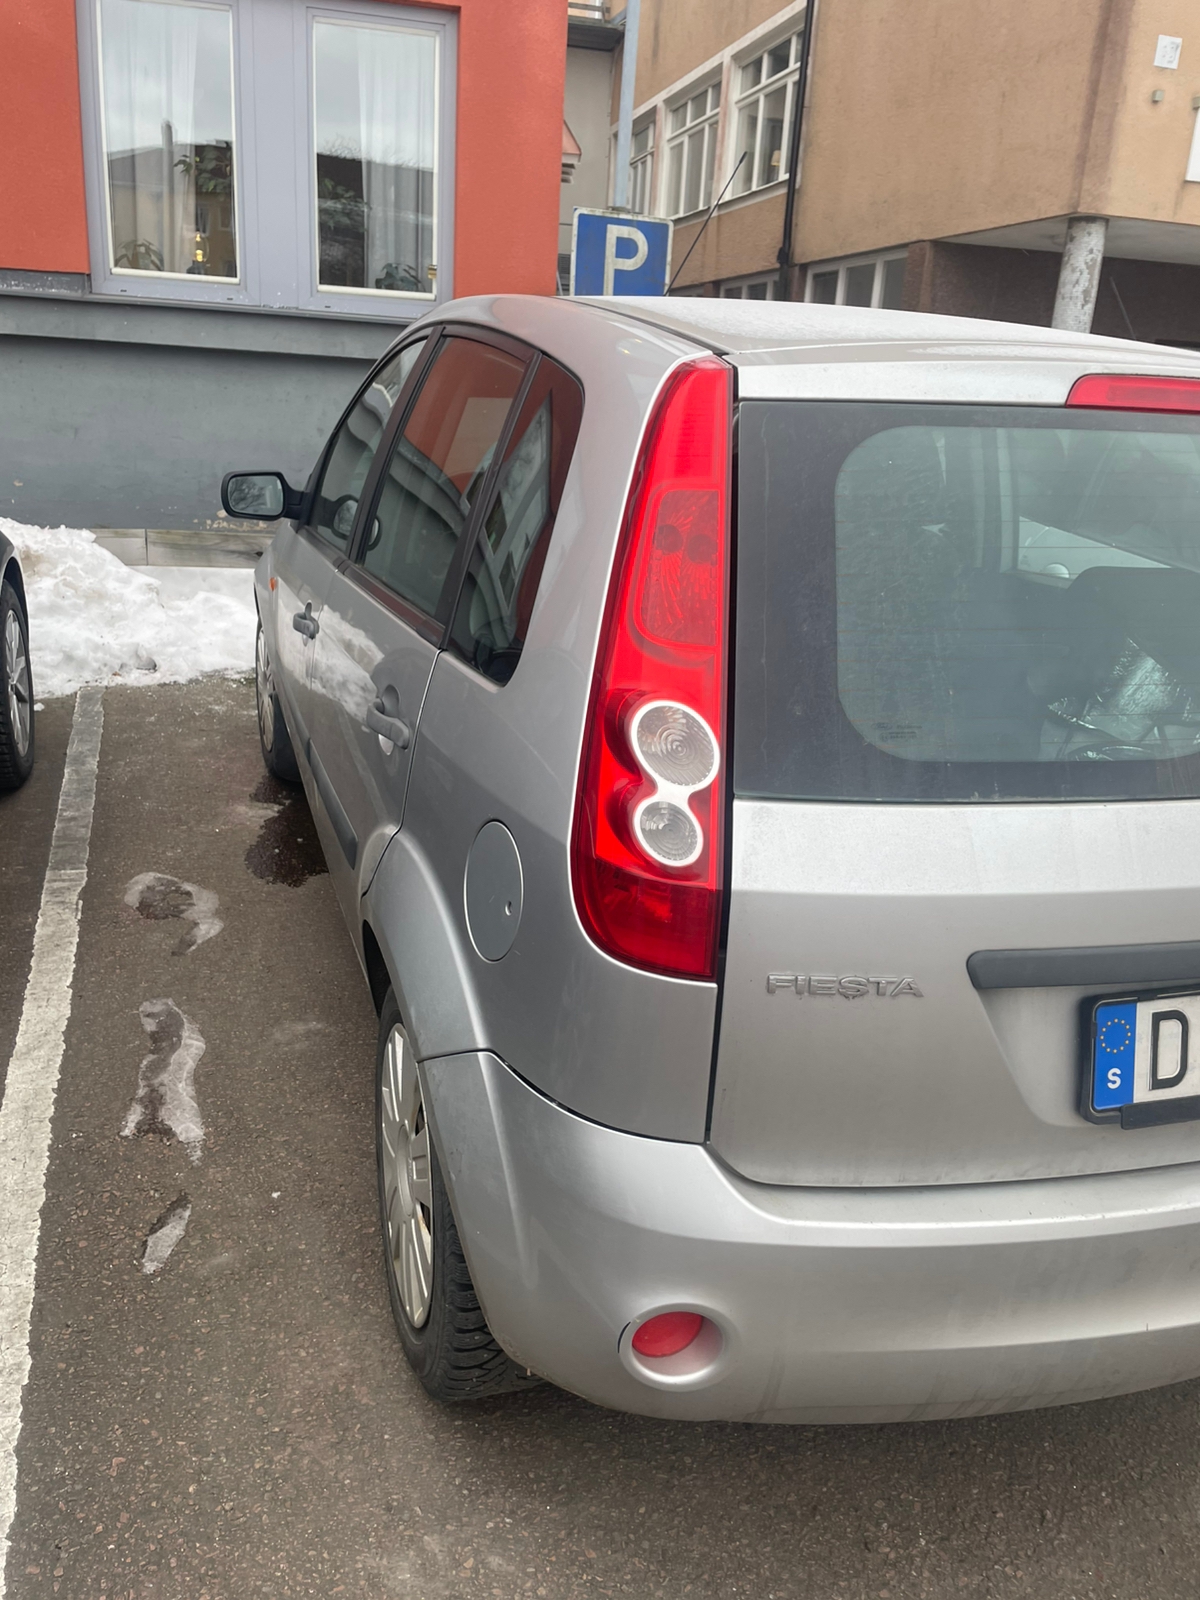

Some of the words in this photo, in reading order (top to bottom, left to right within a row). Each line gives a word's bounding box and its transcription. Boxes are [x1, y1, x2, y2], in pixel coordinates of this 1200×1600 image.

[603, 224, 648, 296] P
[767, 974, 924, 998] FIESTA
[1149, 1009, 1189, 1091] D
[1107, 1067, 1122, 1089] S
